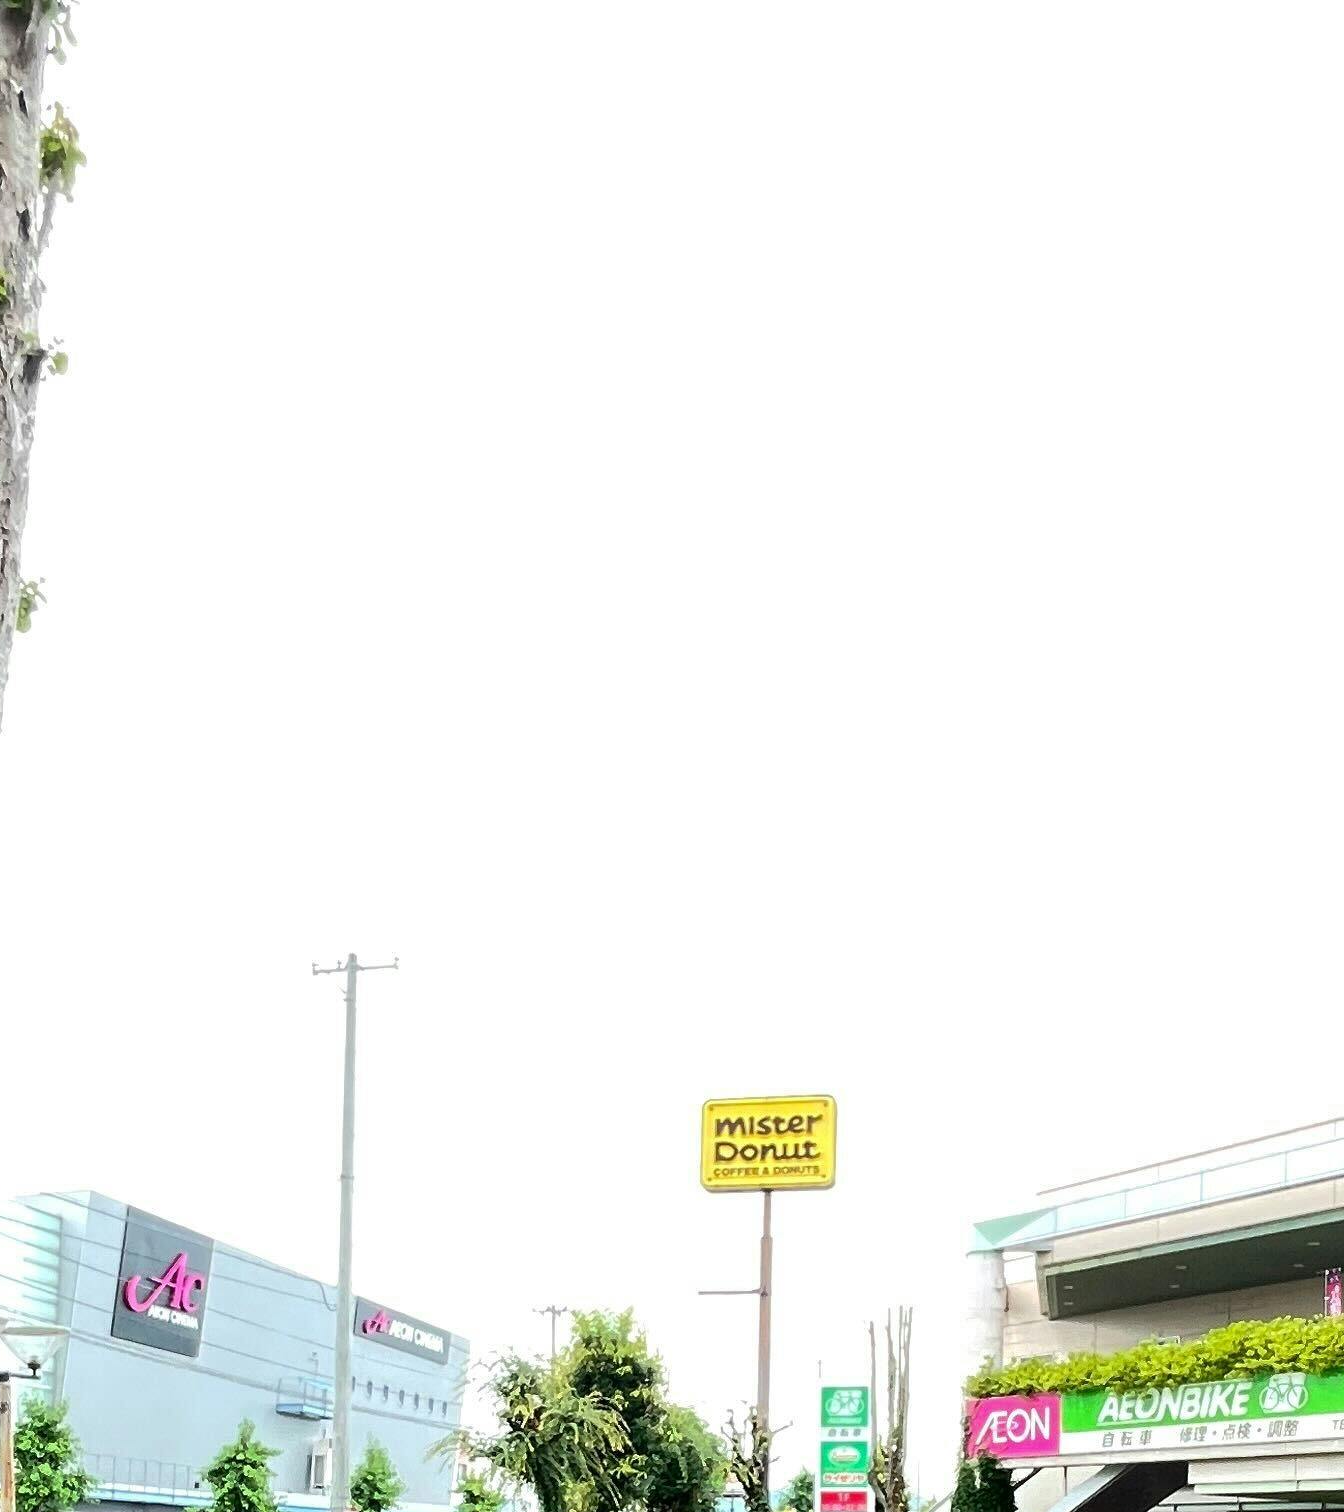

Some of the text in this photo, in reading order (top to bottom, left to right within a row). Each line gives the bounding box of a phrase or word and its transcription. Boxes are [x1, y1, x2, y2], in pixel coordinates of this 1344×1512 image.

[714, 1140, 822, 1163] Donut
[713, 1166, 760, 1178] COFFEE
[773, 1165, 820, 1176] DONUTS
[1097, 1381, 1254, 1424] AEONBIKE
[1102, 1430, 1153, 1448] 自転車
